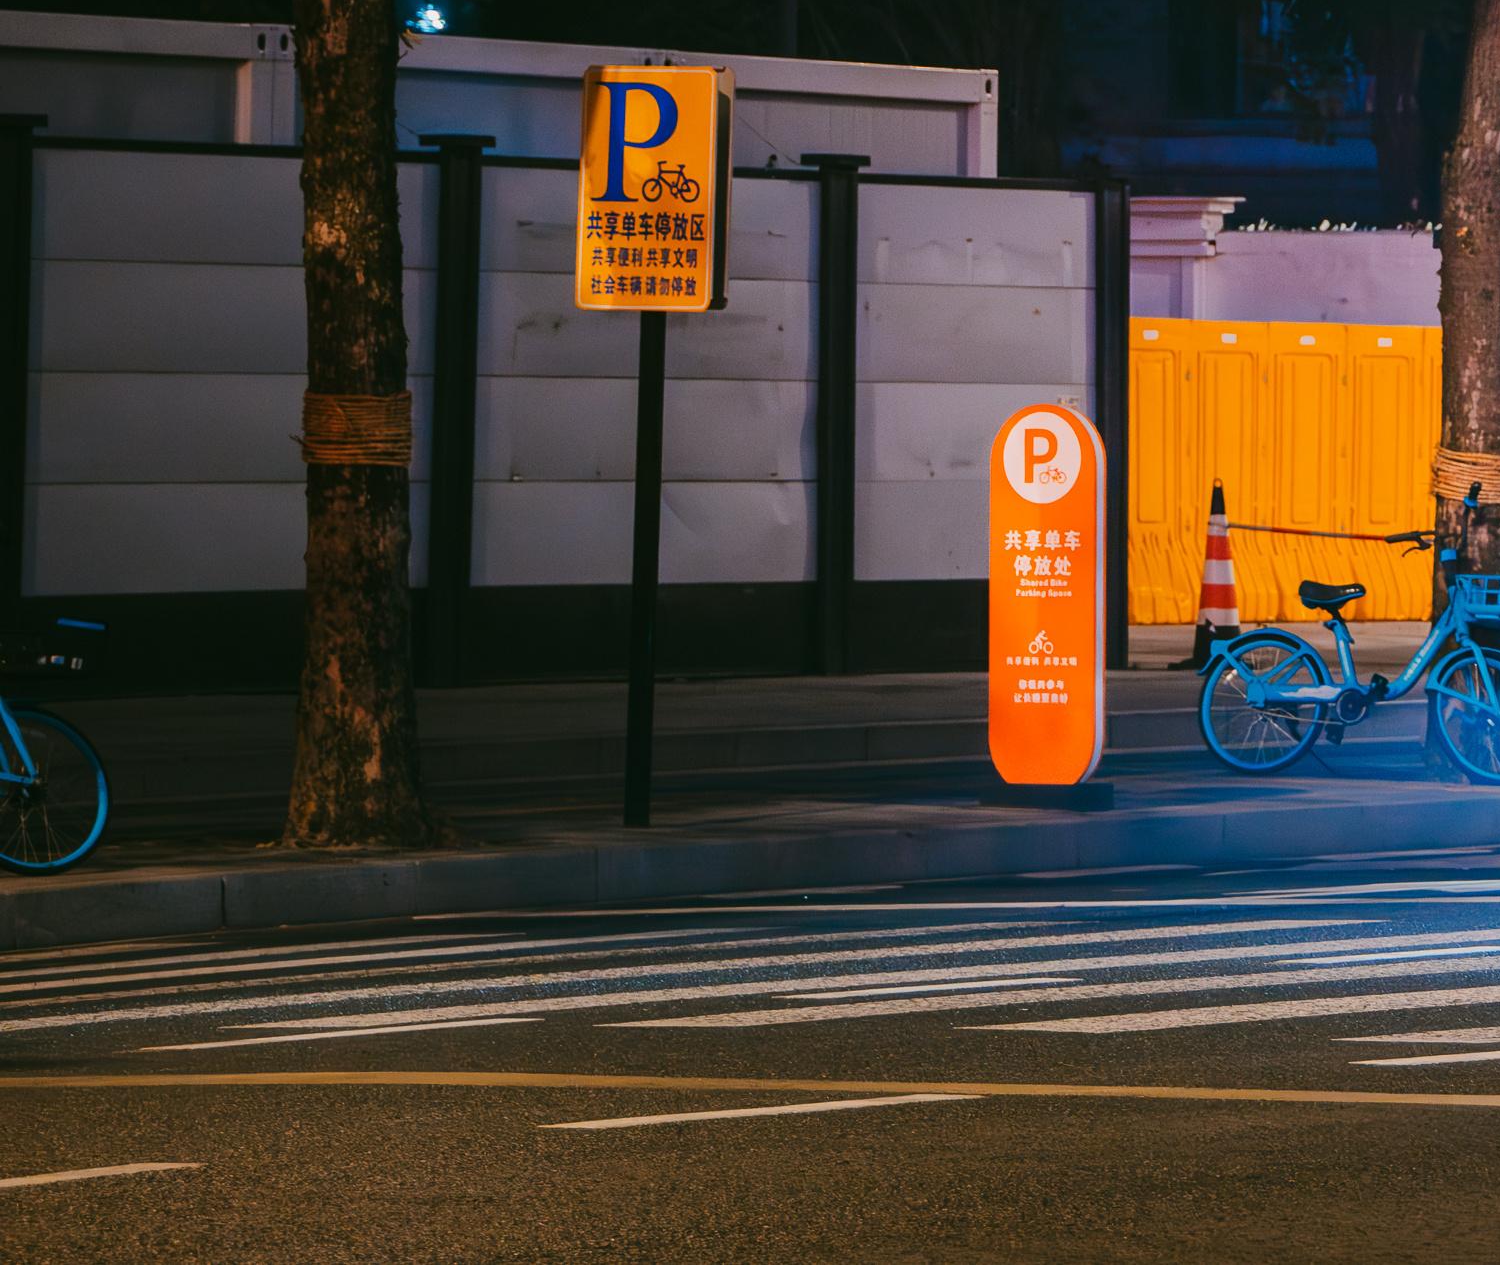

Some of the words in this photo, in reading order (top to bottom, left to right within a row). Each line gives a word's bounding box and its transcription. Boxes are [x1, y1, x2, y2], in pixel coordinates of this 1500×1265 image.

[591, 81, 679, 202] P
[587, 210, 705, 241] 共享单车停放区
[592, 247, 643, 268] 共享便利
[646, 247, 698, 269] 共享文明
[591, 275, 642, 295] 社会车辆
[645, 276, 697, 296] 请勿停放
[1024, 429, 1058, 483] P
[1004, 529, 1081, 551] 共享单车
[1014, 555, 1072, 576] 停放处
